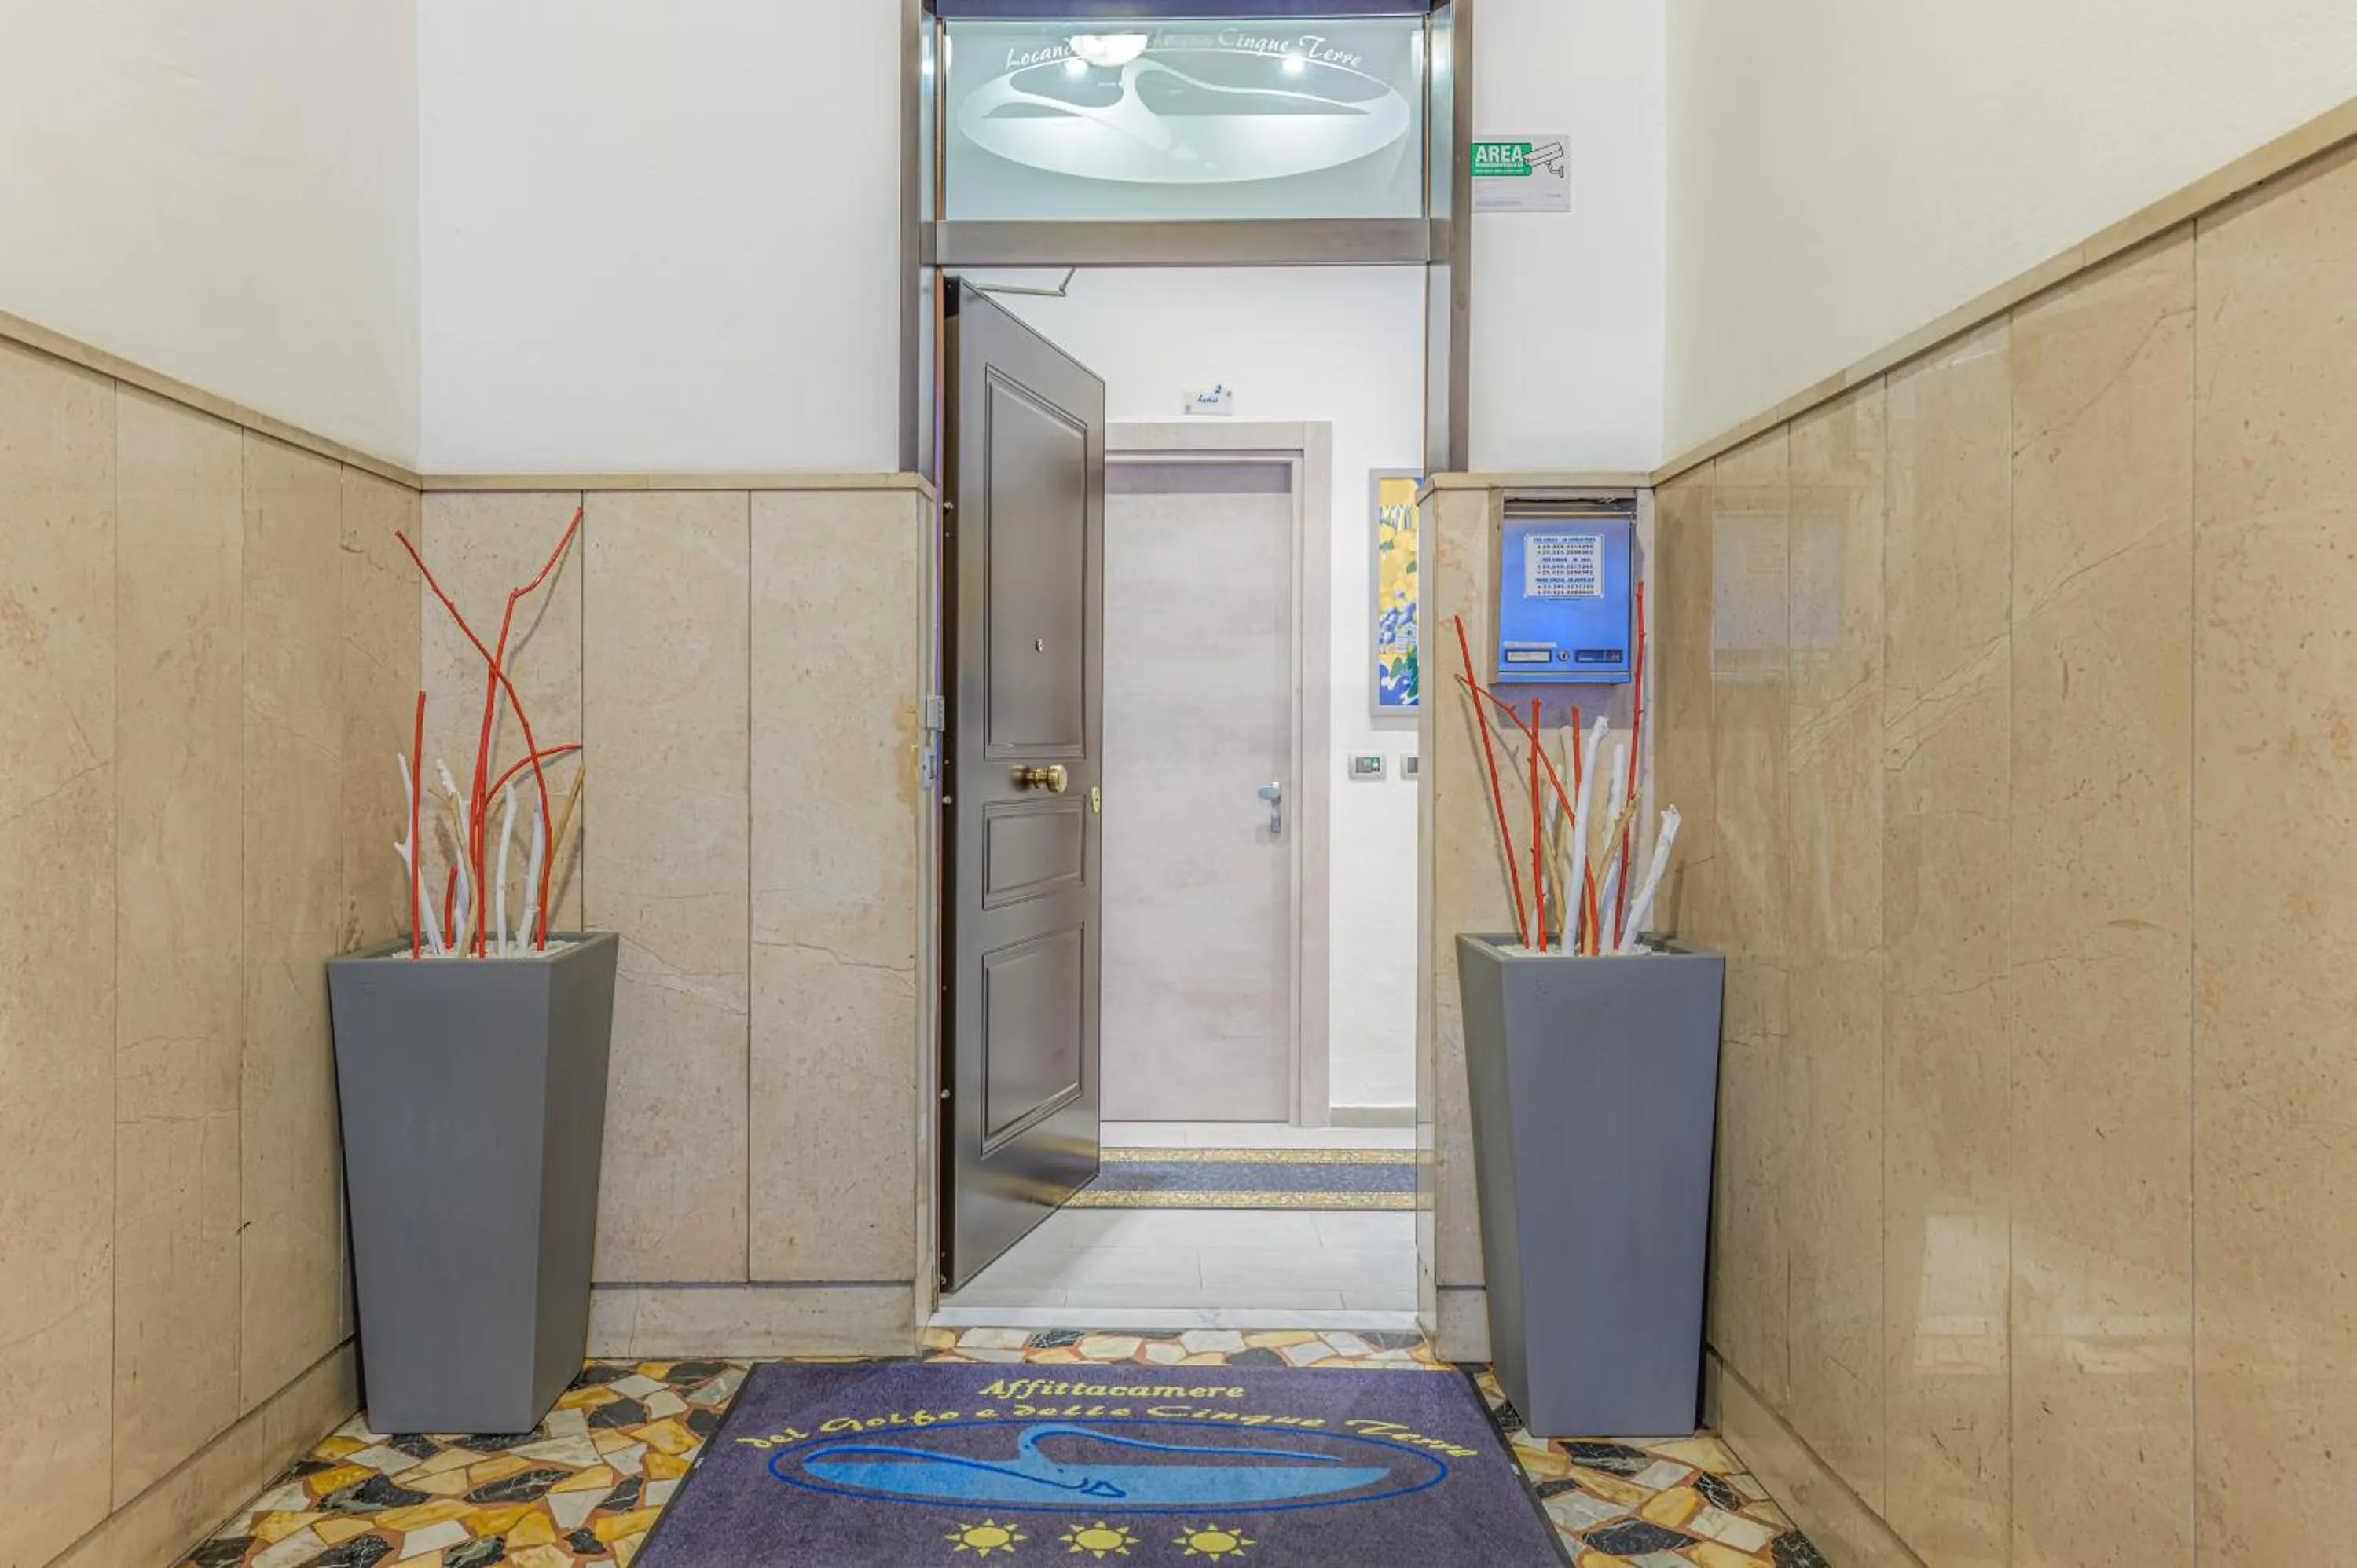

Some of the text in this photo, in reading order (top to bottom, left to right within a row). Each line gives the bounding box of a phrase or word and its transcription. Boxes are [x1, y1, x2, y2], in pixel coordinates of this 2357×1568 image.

[1218, 27, 1290, 57] Cinque
[1299, 35, 1362, 68] Terre
[1475, 144, 1524, 163] AREA
[978, 1378, 1244, 1400] Affittacamere
[975, 1409, 998, 1418] e
[1013, 1404, 1132, 1417] delle
[1146, 1405, 1326, 1427] Cinque
[1345, 1419, 1478, 1457] Terre
